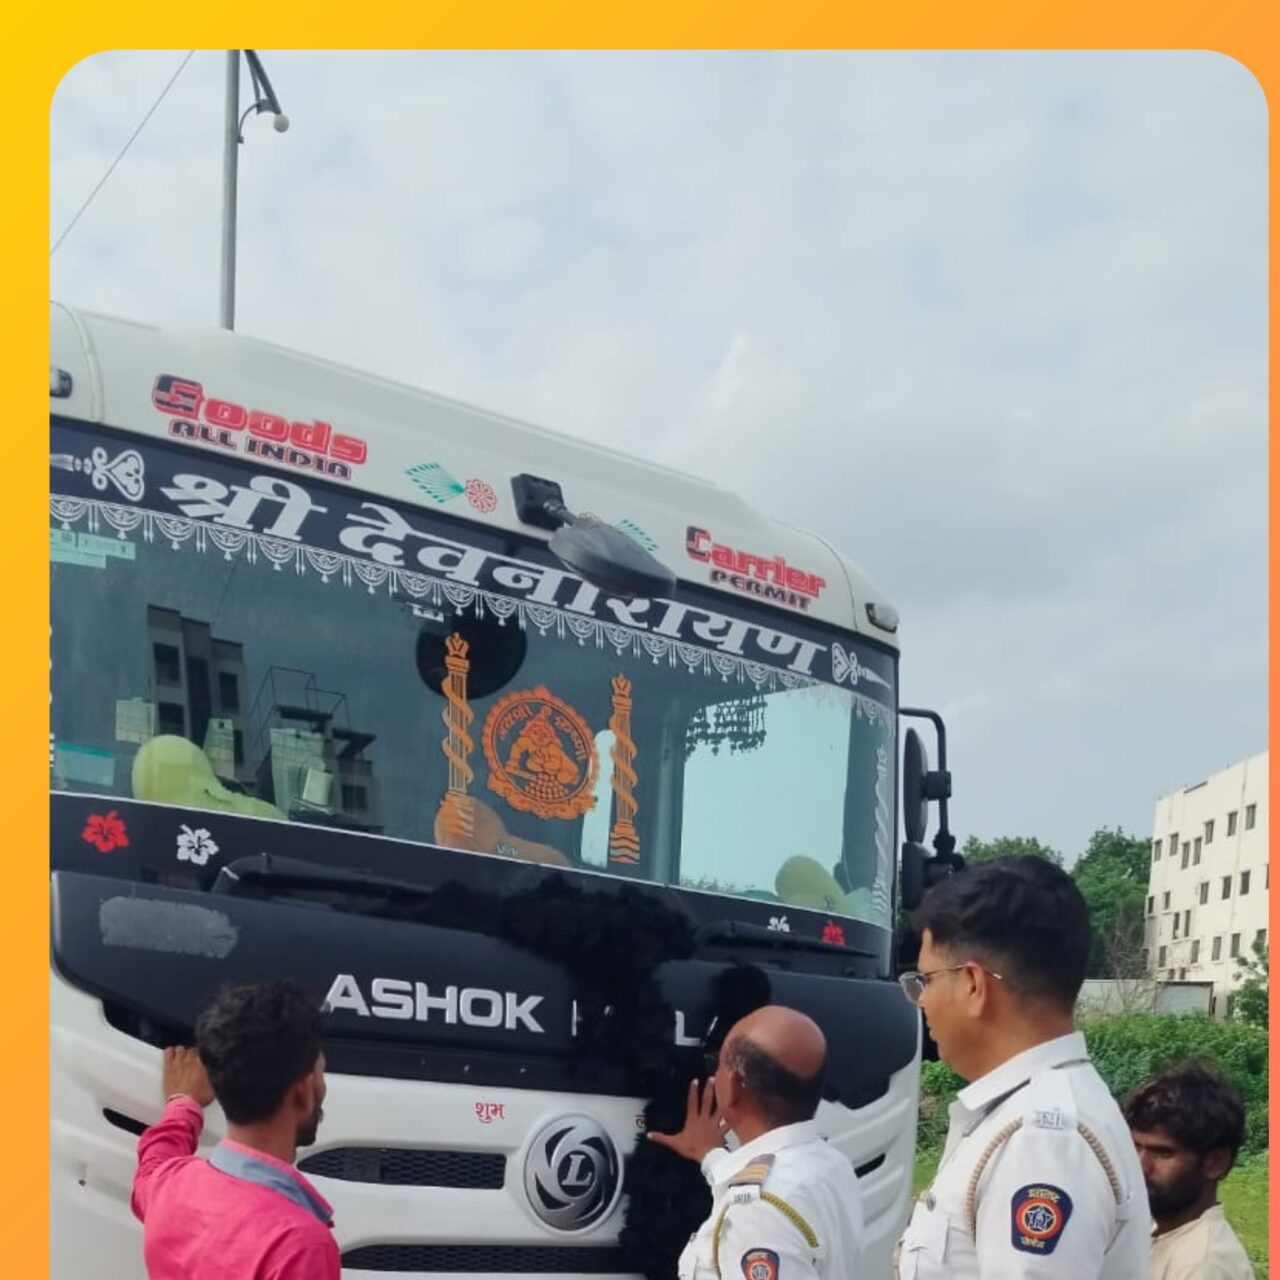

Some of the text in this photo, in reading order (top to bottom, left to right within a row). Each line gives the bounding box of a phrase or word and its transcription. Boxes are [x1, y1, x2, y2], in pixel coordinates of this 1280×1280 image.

[152, 373, 368, 465] Goods
[169, 418, 352, 481] ALL INDIA
[160, 473, 828, 676] श्री देवनारायण
[685, 525, 827, 599] Carrier
[710, 568, 812, 611] PERMIT
[324, 973, 546, 1034] ASHOK
